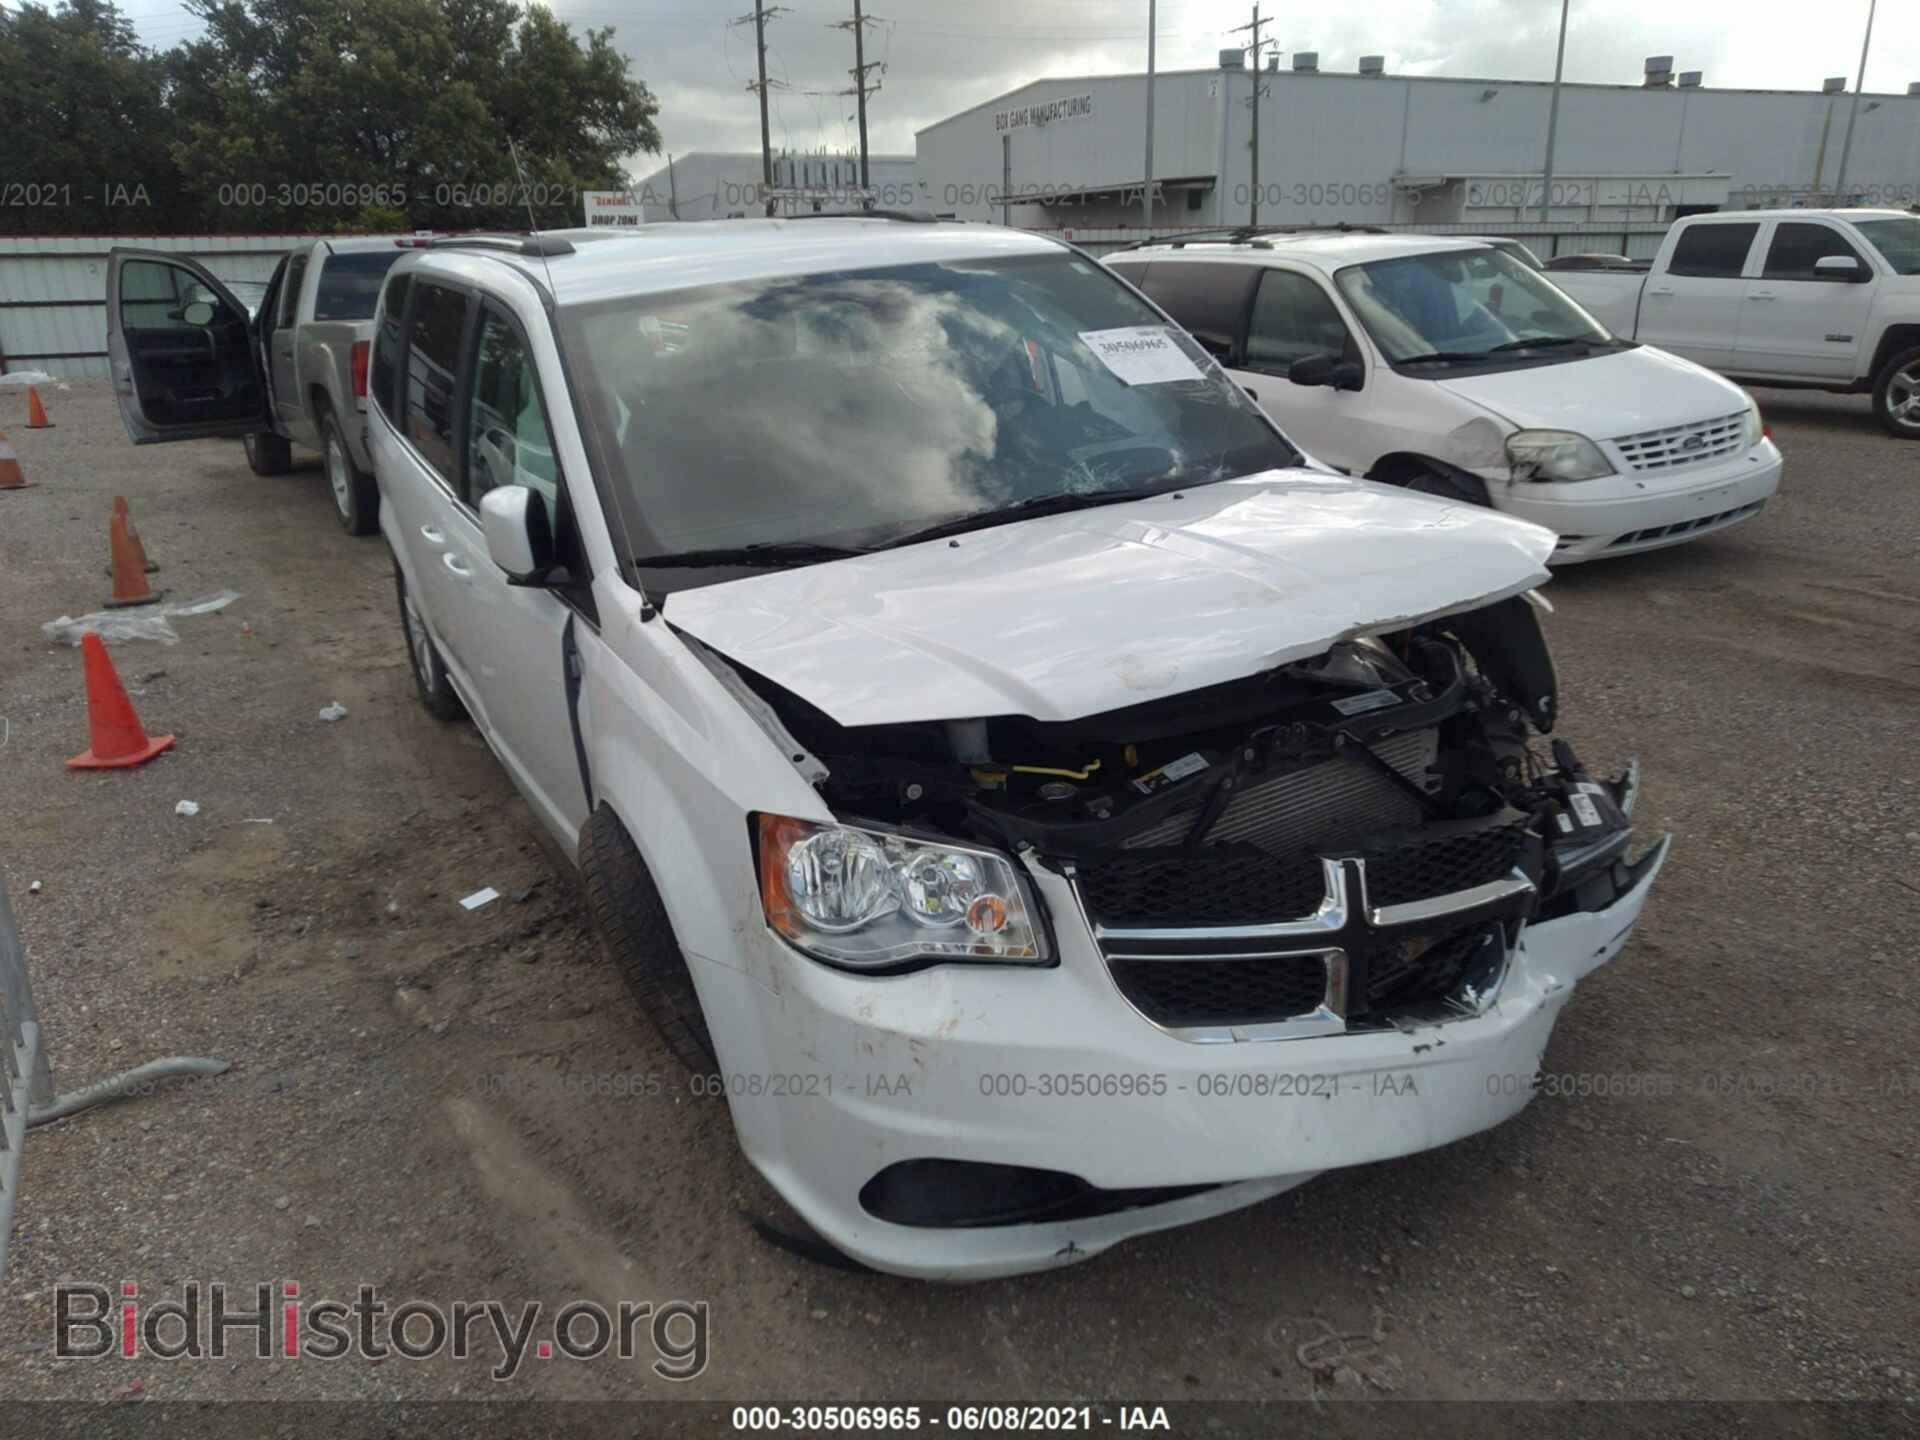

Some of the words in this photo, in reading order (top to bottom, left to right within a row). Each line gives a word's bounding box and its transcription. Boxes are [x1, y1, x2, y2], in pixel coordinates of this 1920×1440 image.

[1009, 108, 1028, 129] GANG
[1029, 95, 1091, 124] MANUFACTURING
[591, 214, 616, 226] DROP
[617, 214, 639, 226] ZONE
[1099, 338, 1169, 354] 30506965
